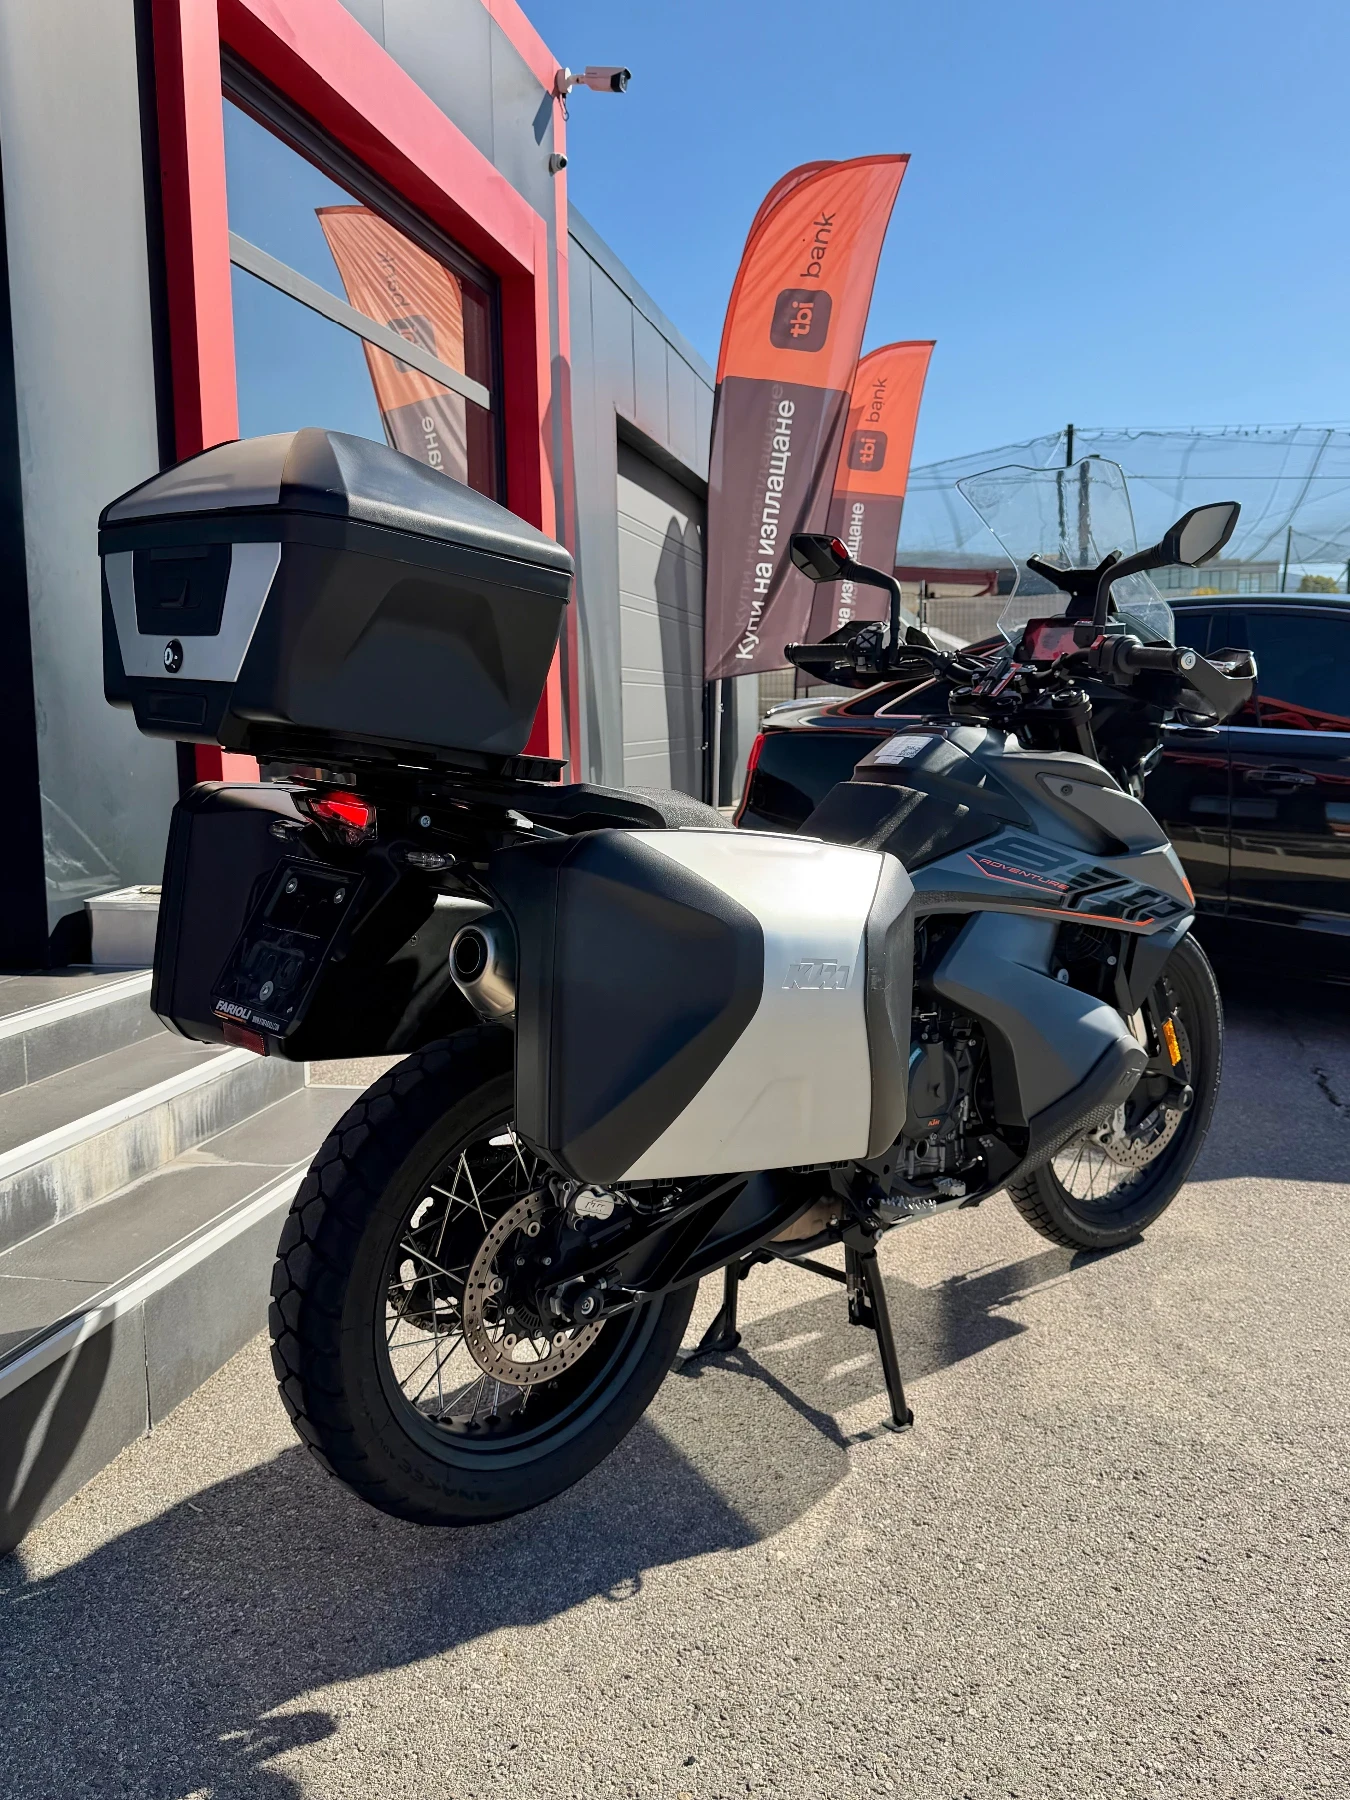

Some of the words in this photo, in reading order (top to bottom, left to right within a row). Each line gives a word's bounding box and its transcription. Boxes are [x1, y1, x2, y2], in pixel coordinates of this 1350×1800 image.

[800, 211, 836, 279] bank
[789, 300, 814, 338] tbi
[865, 377, 888, 423] bank
[859, 438, 877, 464] tbi
[758, 399, 795, 556] изплащане
[753, 562, 773, 594] на
[735, 600, 765, 660] Купи
[979, 858, 1070, 891] ADVENTURE
[781, 958, 851, 990] KTM
[215, 1000, 252, 1020] FARIOLI
